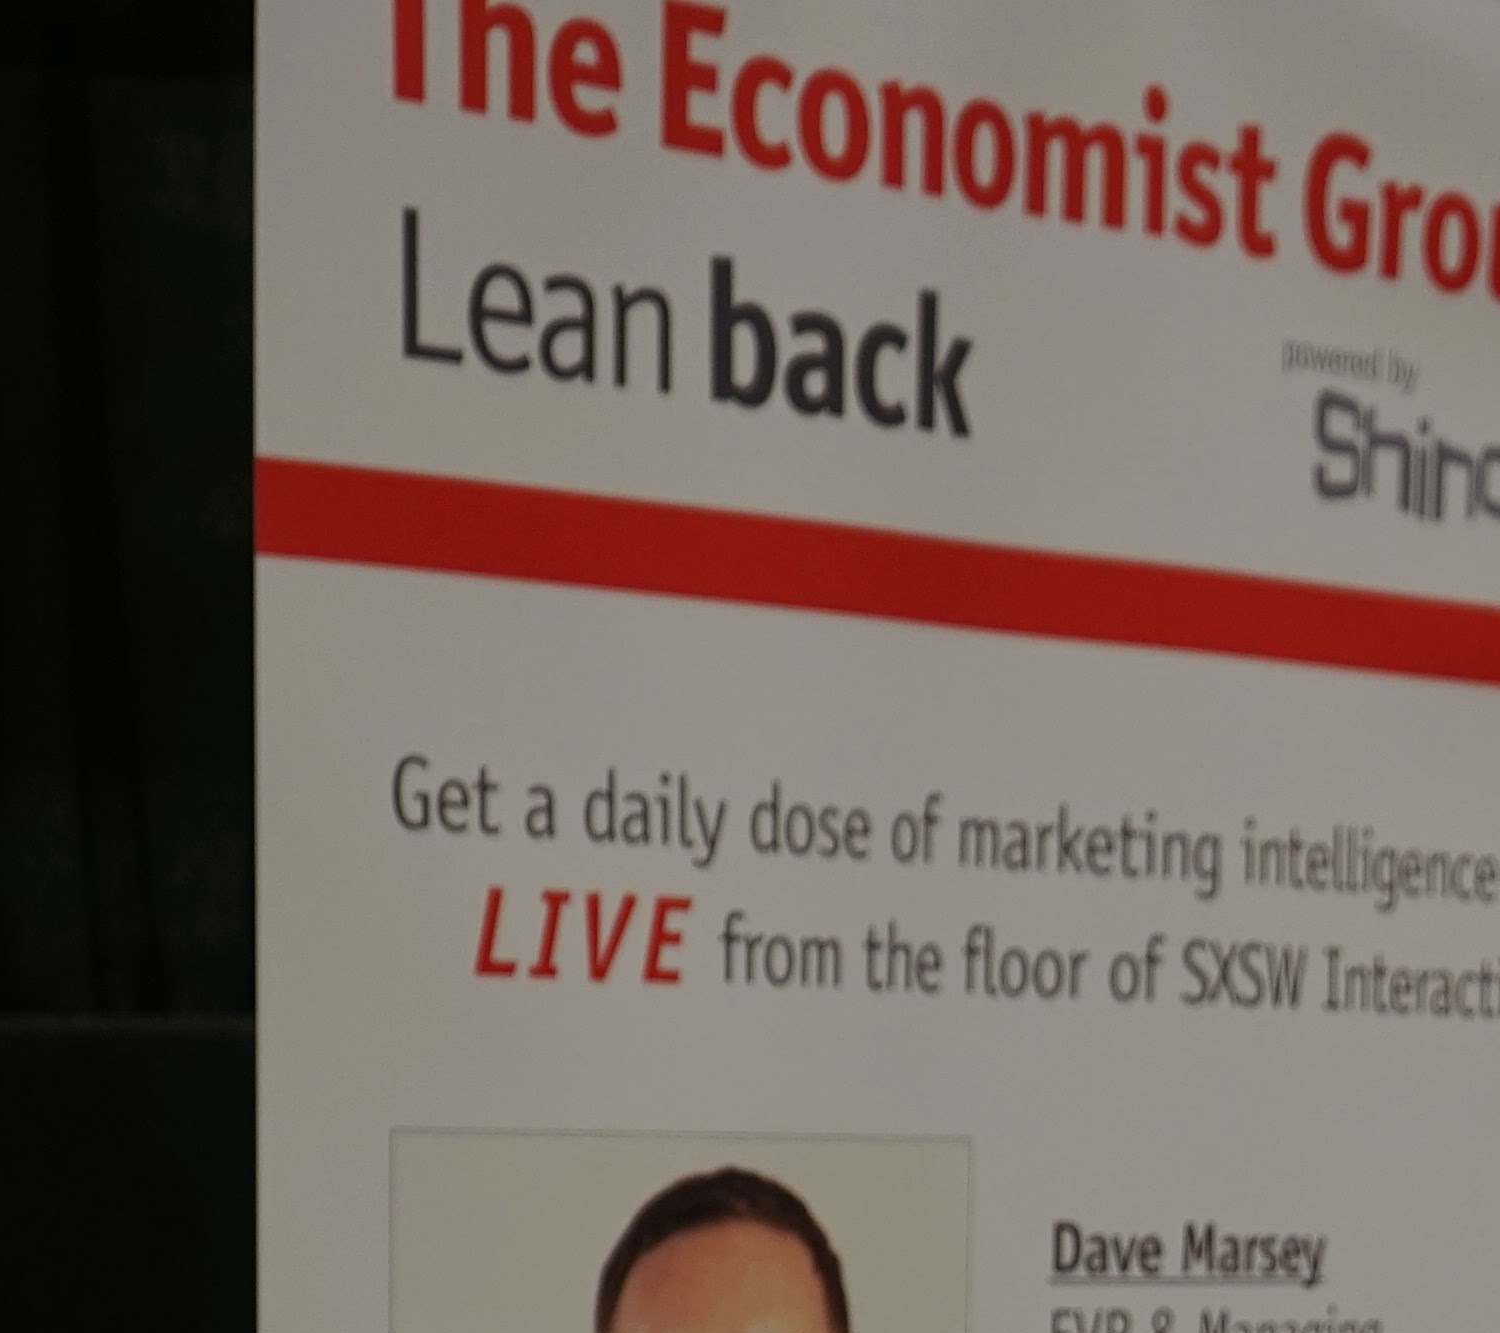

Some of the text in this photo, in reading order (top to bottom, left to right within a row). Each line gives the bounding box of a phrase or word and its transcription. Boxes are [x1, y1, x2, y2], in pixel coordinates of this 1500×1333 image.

[659, 0, 1279, 260] Economist
[401, 205, 974, 440] Lean back
[1280, 340, 1421, 393] powered by
[390, 752, 502, 838] Get
[523, 782, 559, 841] a
[582, 766, 729, 872] daily
[748, 778, 875, 863] dose
[889, 790, 945, 867] of
[957, 803, 1224, 904] marketing
[473, 885, 693, 986] LIVE
[718, 906, 844, 990] from
[862, 918, 945, 997] the
[960, 920, 1091, 1002] floor
[1107, 931, 1168, 1005] of
[1180, 936, 1309, 1011] SXSW
[1051, 1218, 1327, 1293] Dave Marsey
